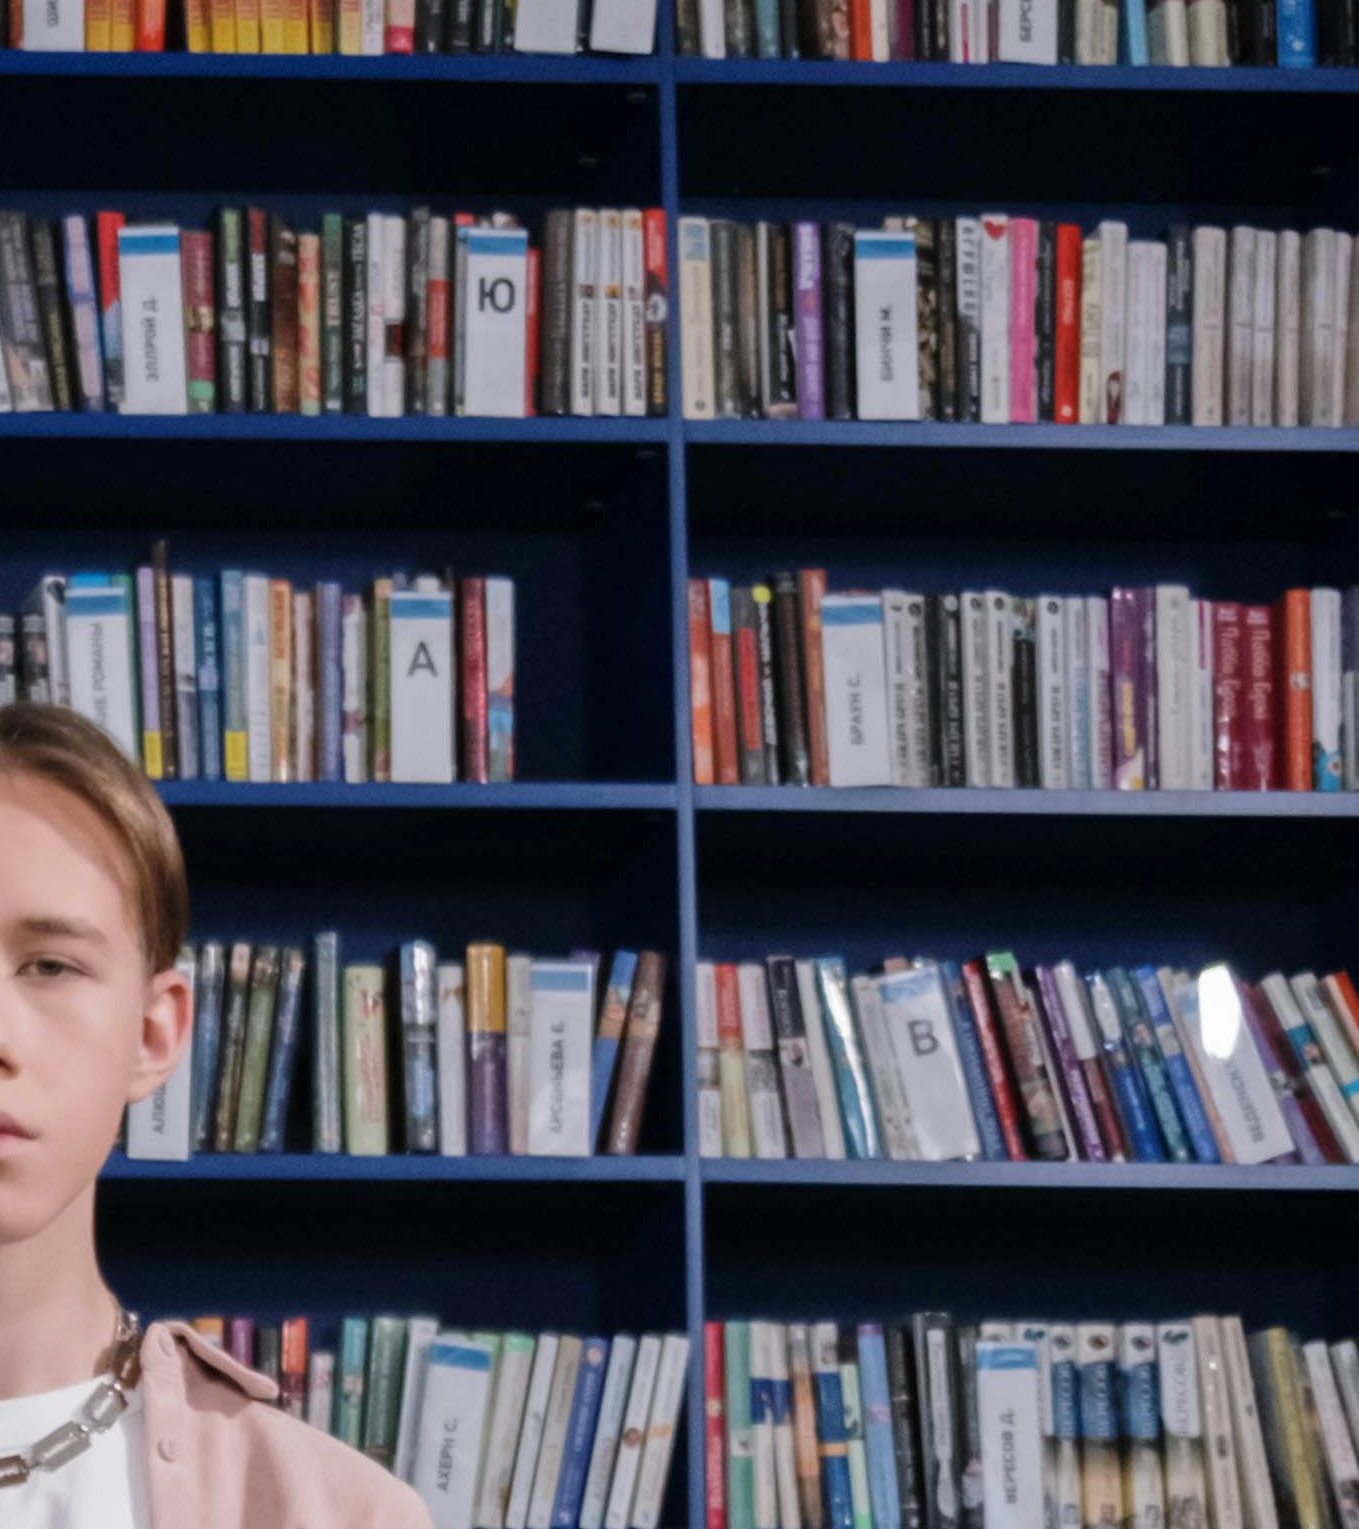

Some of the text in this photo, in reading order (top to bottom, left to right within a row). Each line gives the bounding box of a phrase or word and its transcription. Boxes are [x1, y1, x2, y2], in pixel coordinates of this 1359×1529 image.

[477, 276, 517, 315] Ю
[140, 315, 159, 383] ЭЛЛРОЙ
[89, 622, 106, 691] РОМАНЫ
[406, 639, 439, 678] А
[846, 671, 865, 747] БРАУН С.
[908, 1019, 941, 1058] В
[547, 1038, 565, 1135] АРСЕНЬЕВА
[436, 1417, 458, 1494] АХЕРН С.
[1001, 1429, 1018, 1505] ВЕРЕСОВ
